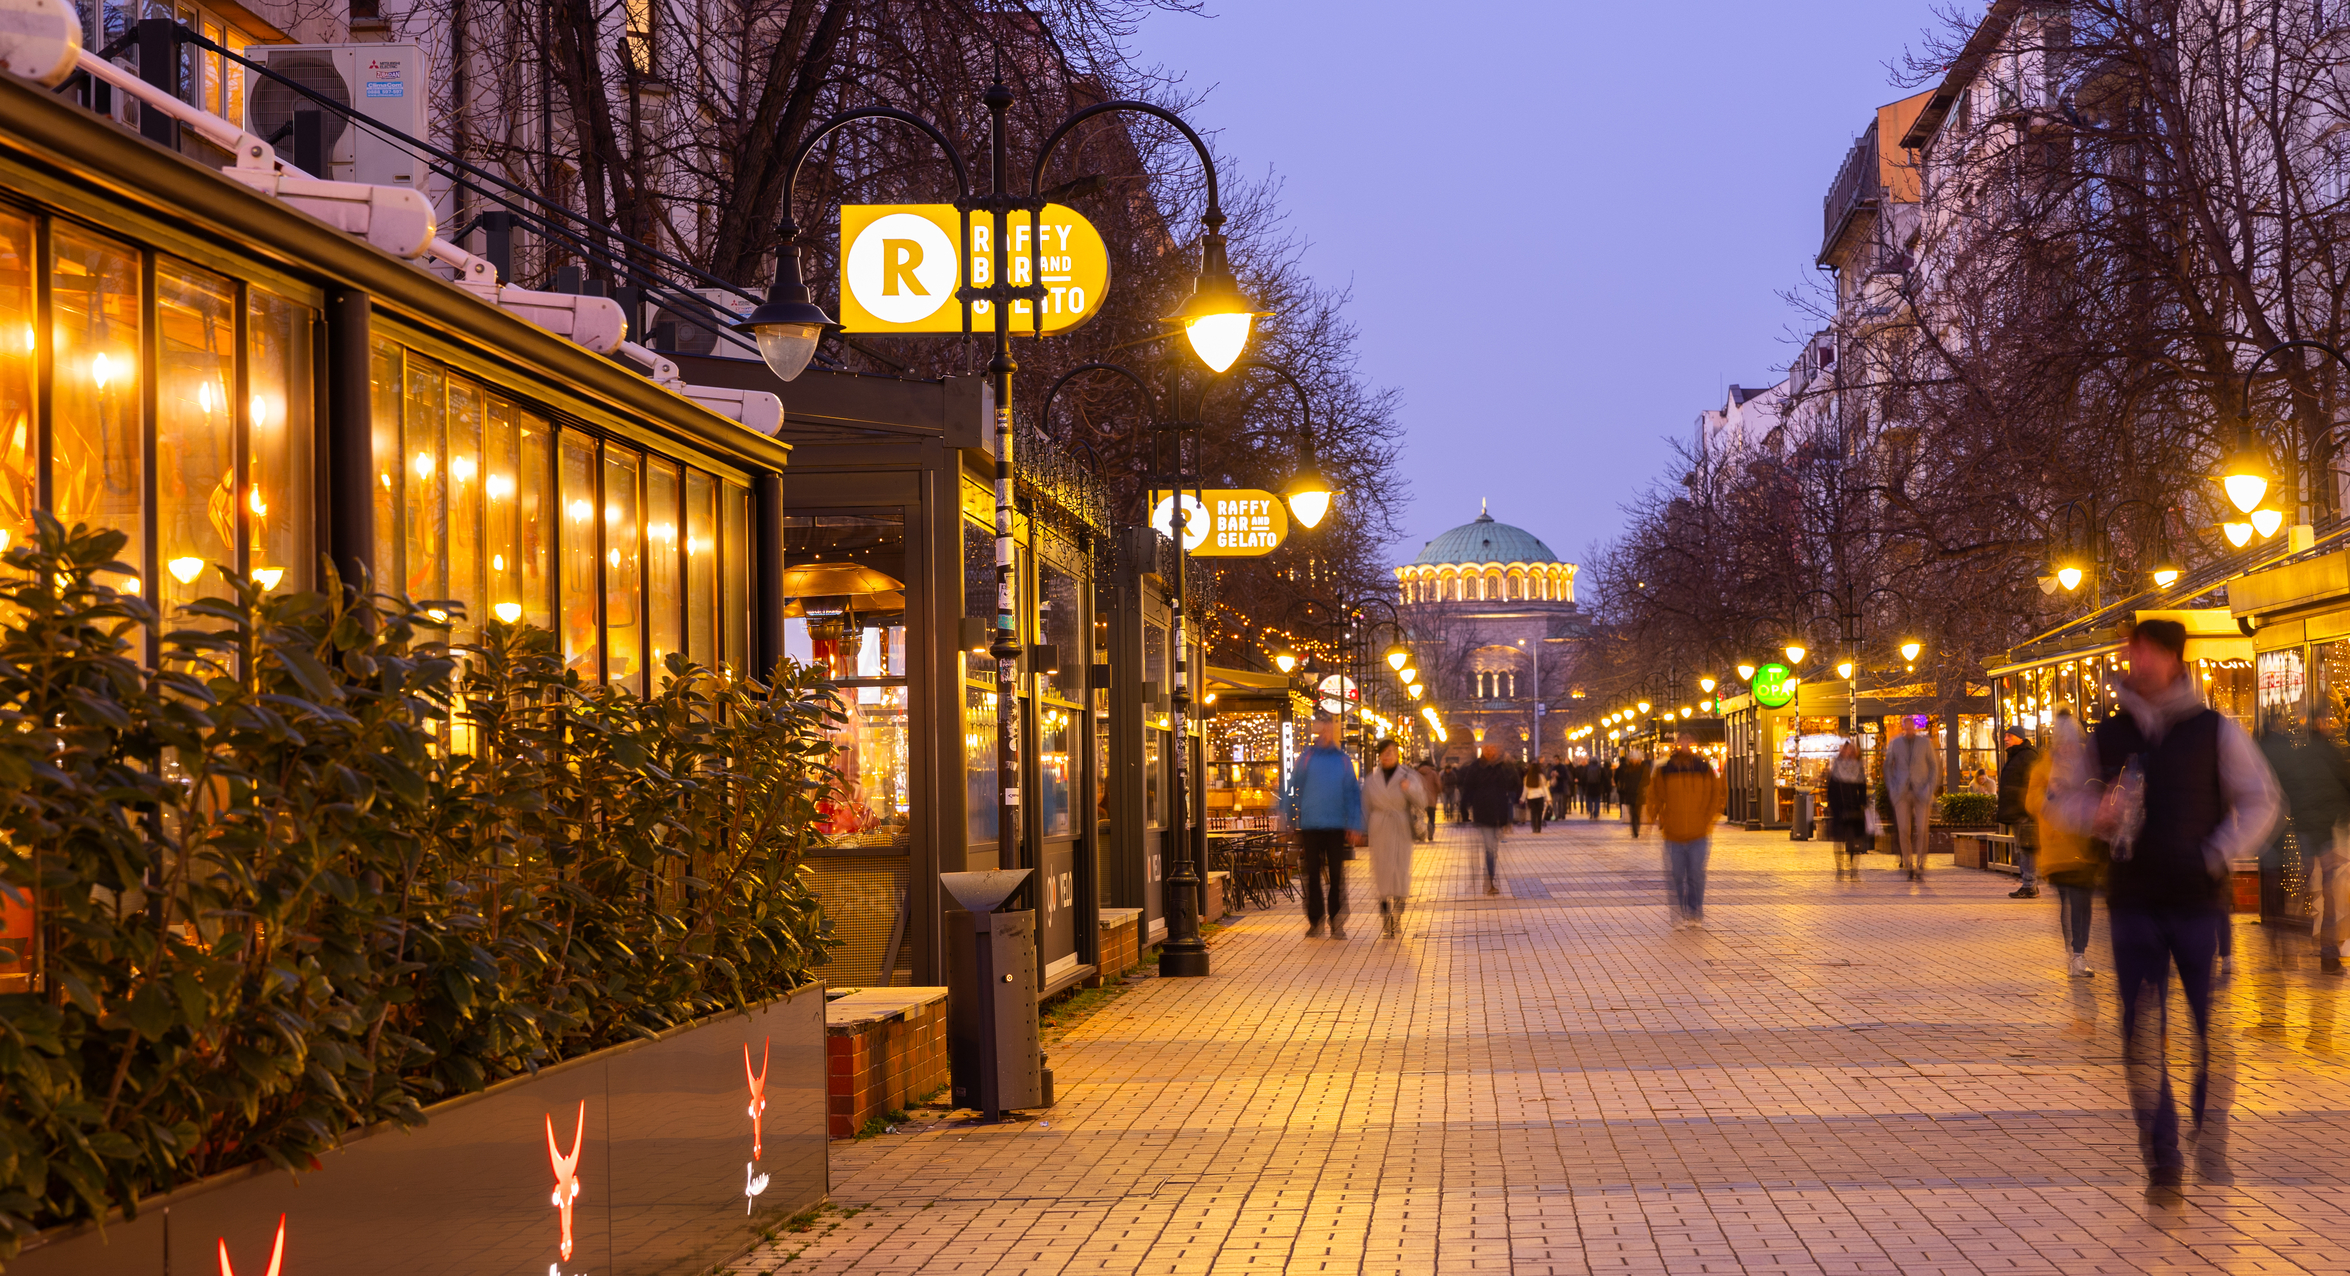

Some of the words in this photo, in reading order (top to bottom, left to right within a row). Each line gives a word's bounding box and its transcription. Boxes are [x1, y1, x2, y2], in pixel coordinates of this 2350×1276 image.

[974, 225, 1073, 252] RFFY
[882, 238, 931, 296] R
[974, 256, 1031, 283] BR
[1040, 256, 1072, 272] AND
[973, 287, 1084, 314] GLTO
[1217, 500, 1270, 515] RAFFY
[1217, 516, 1248, 531] BAR
[1251, 516, 1270, 526] AND
[1217, 532, 1277, 547] GELATO
[1757, 684, 1791, 697] OPA
[1059, 871, 1073, 908] YELO
